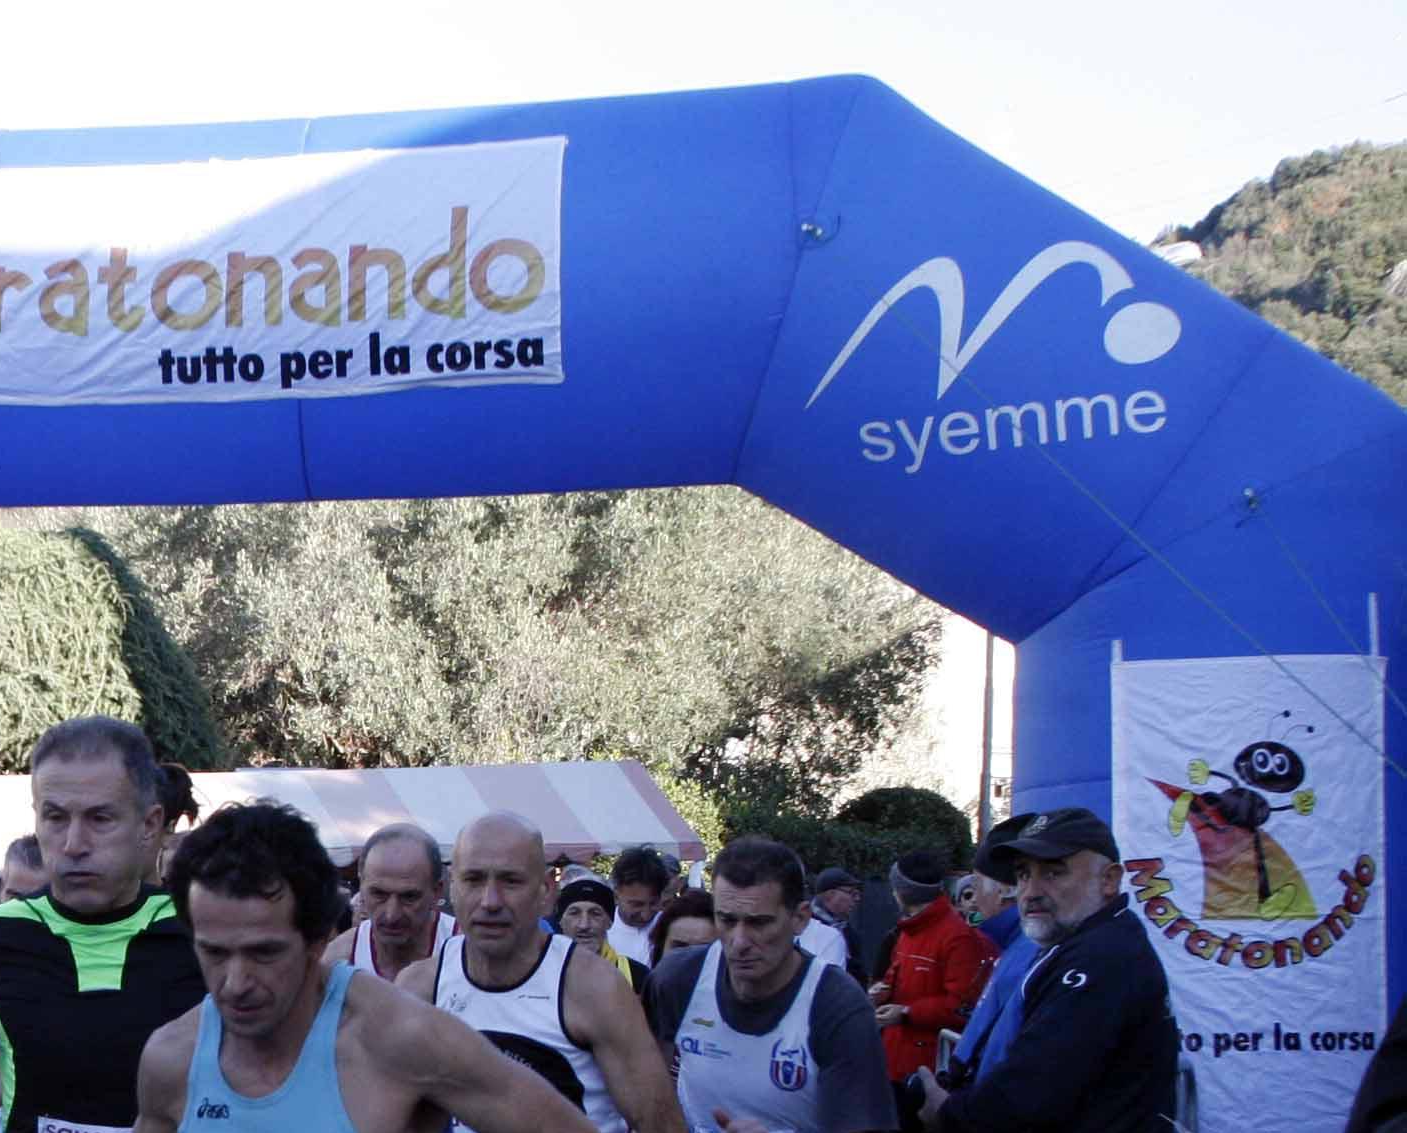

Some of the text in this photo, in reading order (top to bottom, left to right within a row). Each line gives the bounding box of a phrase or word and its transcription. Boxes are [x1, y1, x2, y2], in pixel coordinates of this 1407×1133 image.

[158, 332, 545, 390] tutto per la corsa
[858, 389, 1168, 474] syemme
[1124, 853, 1377, 970] Maratonando
[1213, 1031, 1264, 1057] per
[1273, 1023, 1301, 1051] la
[1310, 1031, 1375, 1051] corsa
